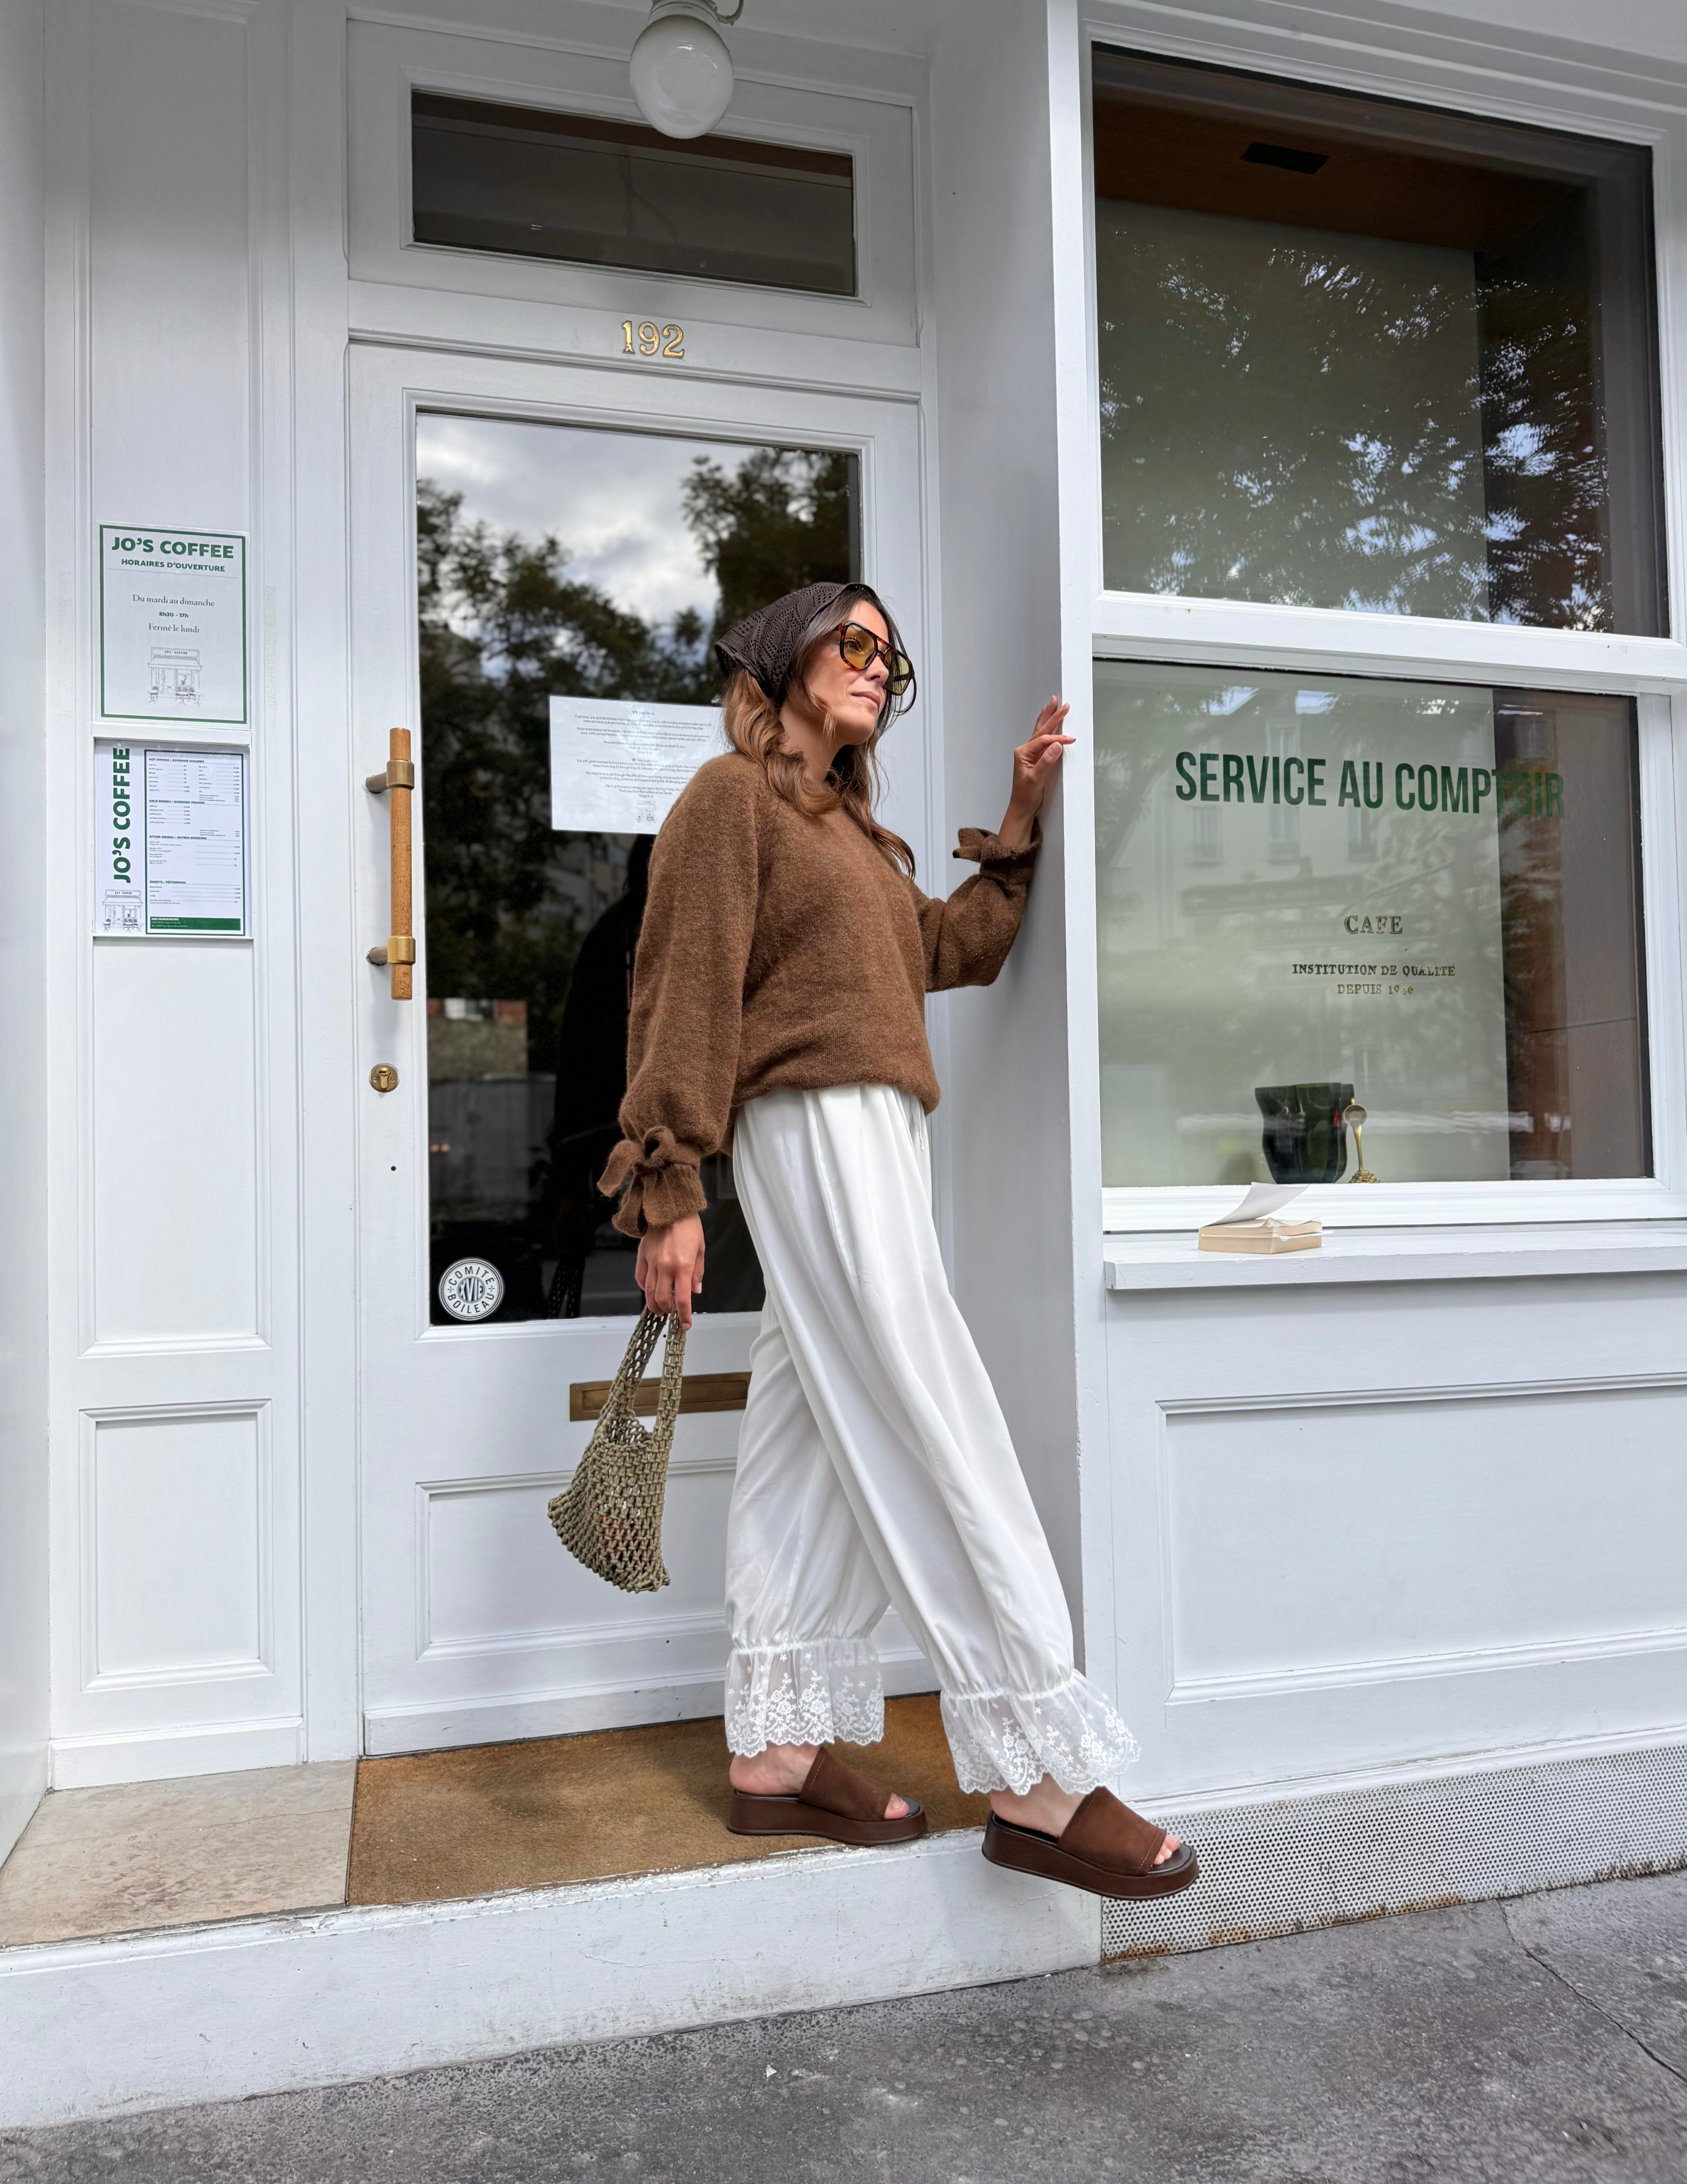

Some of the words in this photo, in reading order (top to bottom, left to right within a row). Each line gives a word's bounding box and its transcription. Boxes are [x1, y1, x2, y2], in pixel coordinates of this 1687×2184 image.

[622, 320, 685, 359] 192
[111, 537, 154, 553] JO'S
[160, 541, 234, 559] COFFEE
[121, 559, 165, 568] HORAIRES
[167, 562, 225, 572] D'OUVERTURE
[180, 597, 215, 606] dimanche
[149, 623, 172, 631] Fermé
[181, 625, 199, 633] lundi
[113, 747, 131, 830] COFFEE
[1175, 751, 1327, 807] SERVICE
[1338, 760, 1384, 809] AU
[1395, 762, 1565, 818] COMPTOIR
[112, 837, 131, 883] JO'S
[1292, 964, 1377, 975] INSTITUTION
[1380, 965, 1397, 975] DE
[1337, 984, 1382, 994] DEPUIS
[448, 1266, 496, 1285] COMITÉ
[447, 1293, 495, 1314] BOILEAU
